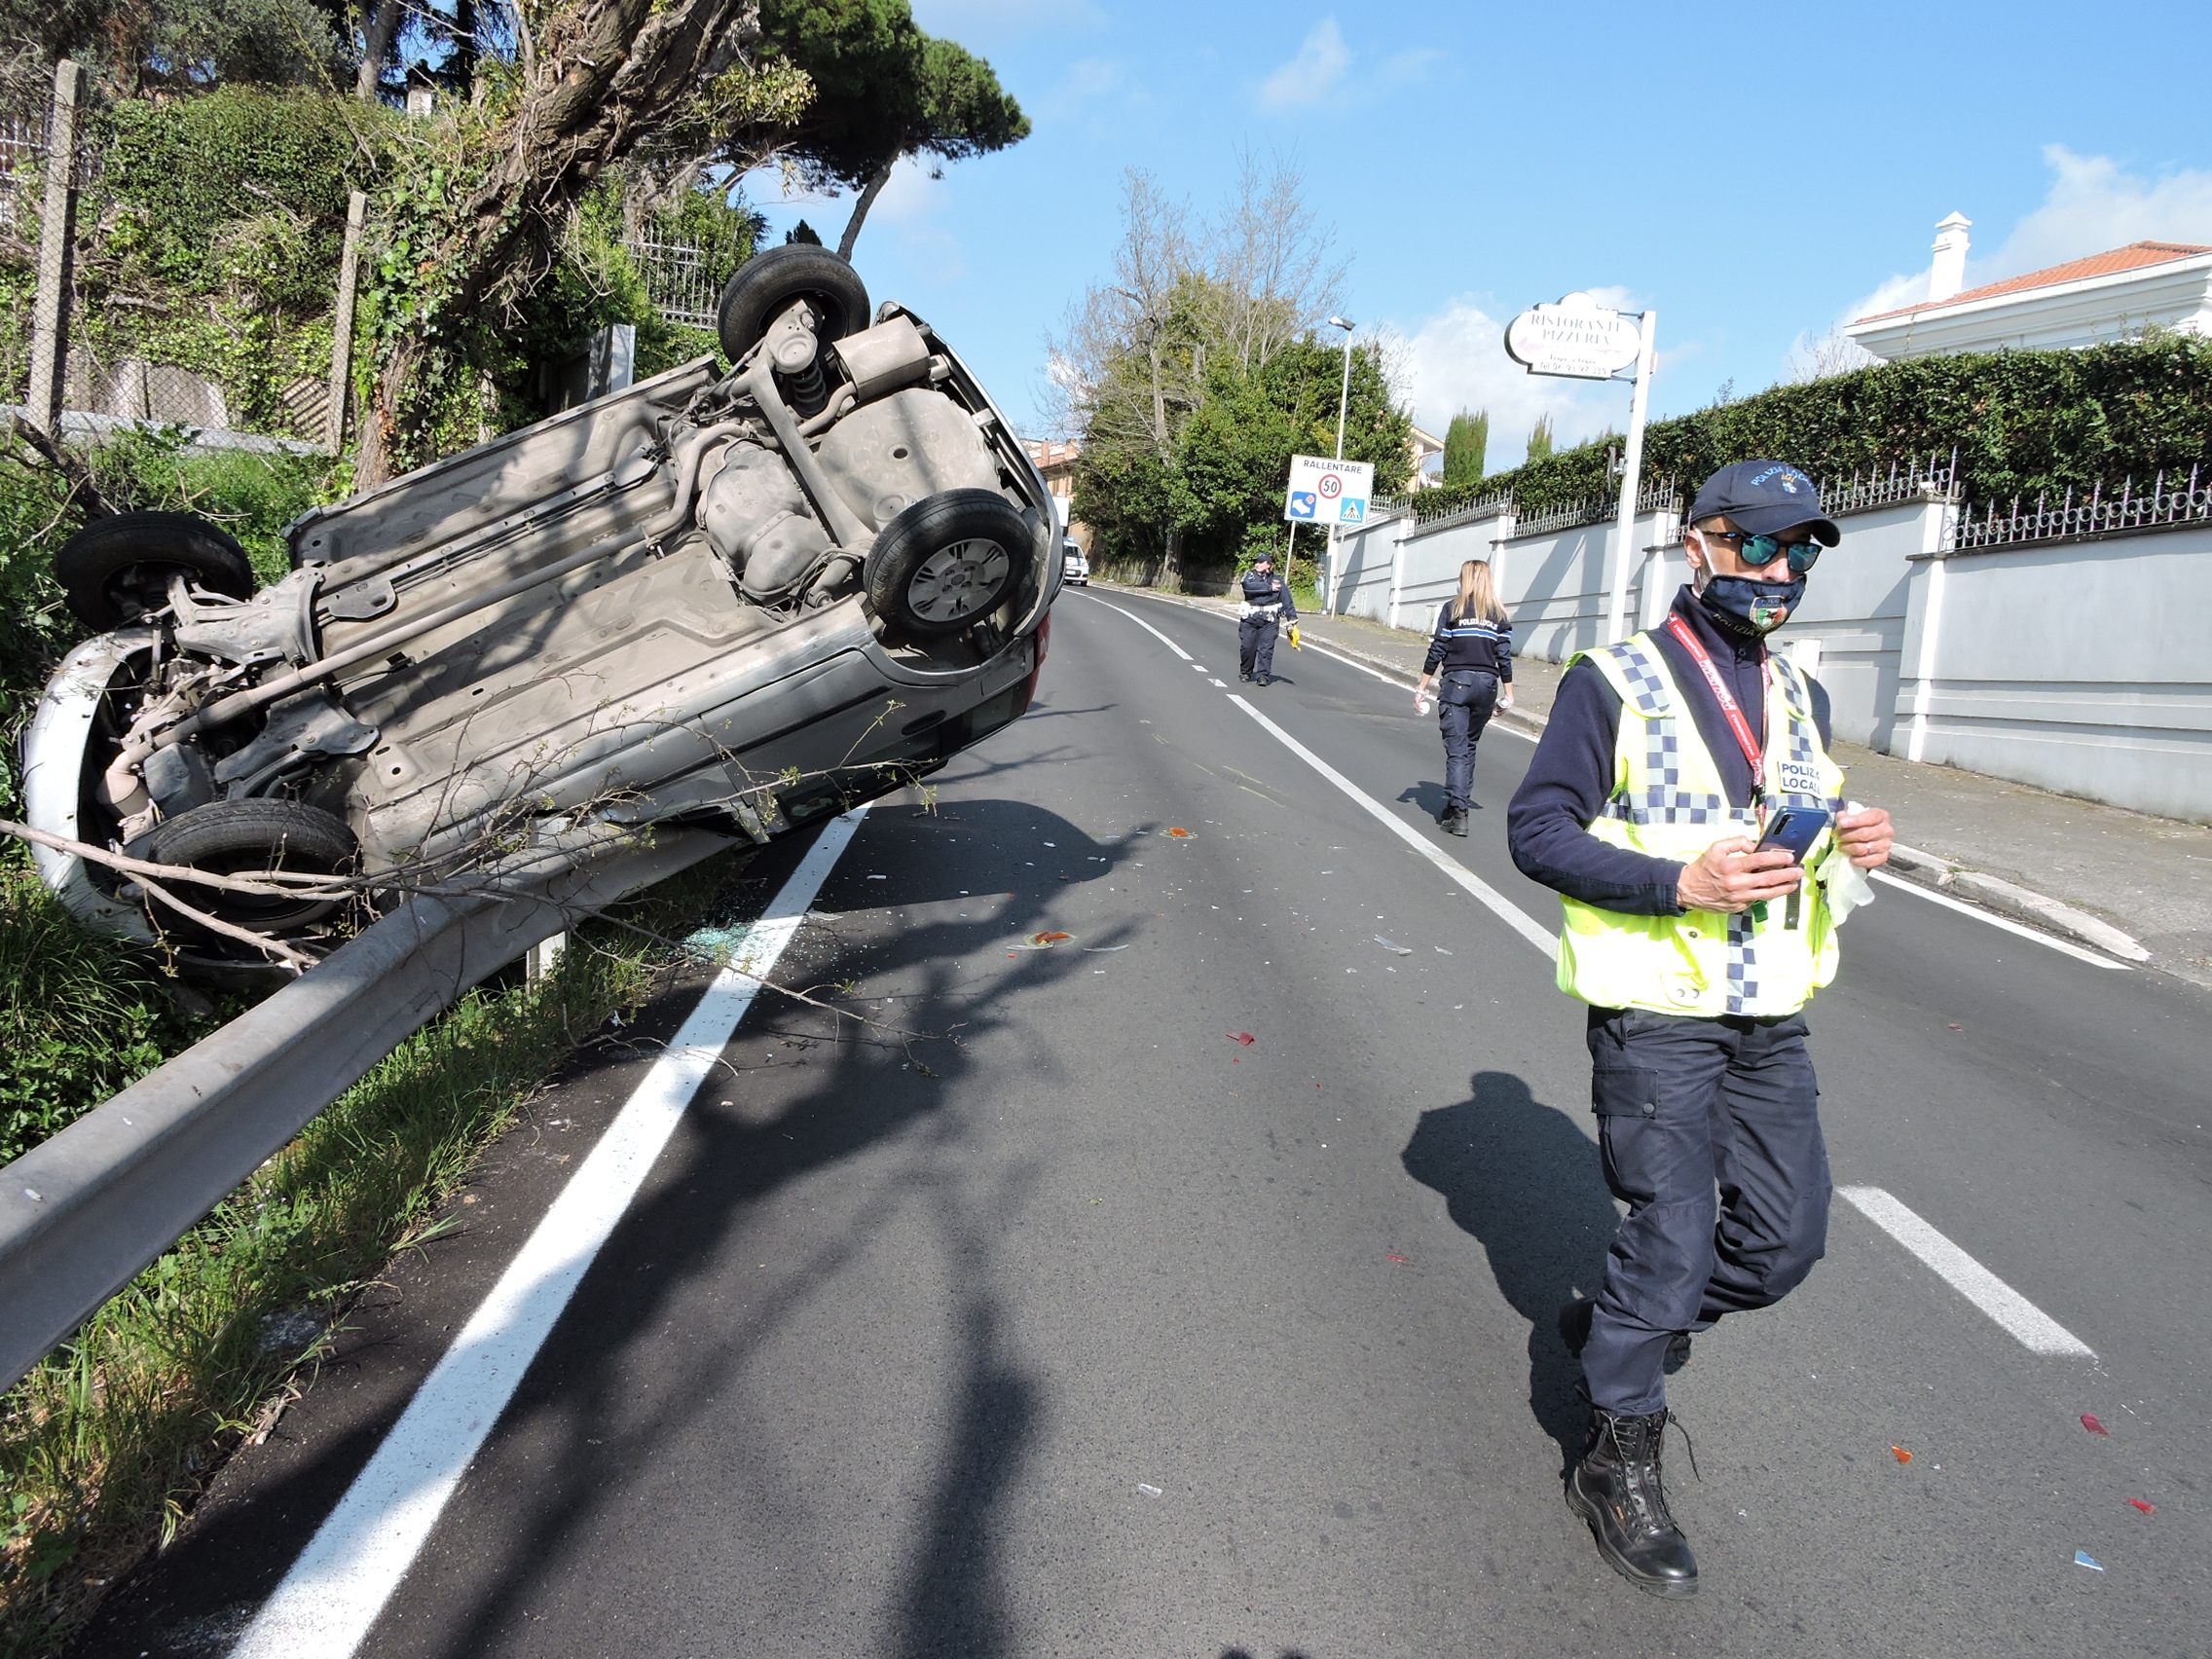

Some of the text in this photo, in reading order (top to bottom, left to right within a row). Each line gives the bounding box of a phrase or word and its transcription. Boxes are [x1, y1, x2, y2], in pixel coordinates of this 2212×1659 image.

[1531, 313, 1621, 332] RISTORANTE
[1543, 329, 1609, 346] PIZZERIA
[1303, 460, 1362, 474] RALLENTARE
[1751, 466, 1785, 486] POLIZIA
[1323, 480, 1338, 494] 50
[1458, 618, 1498, 631] POLIZIA LOCALE
[1700, 658, 1737, 711] POLIZIA
